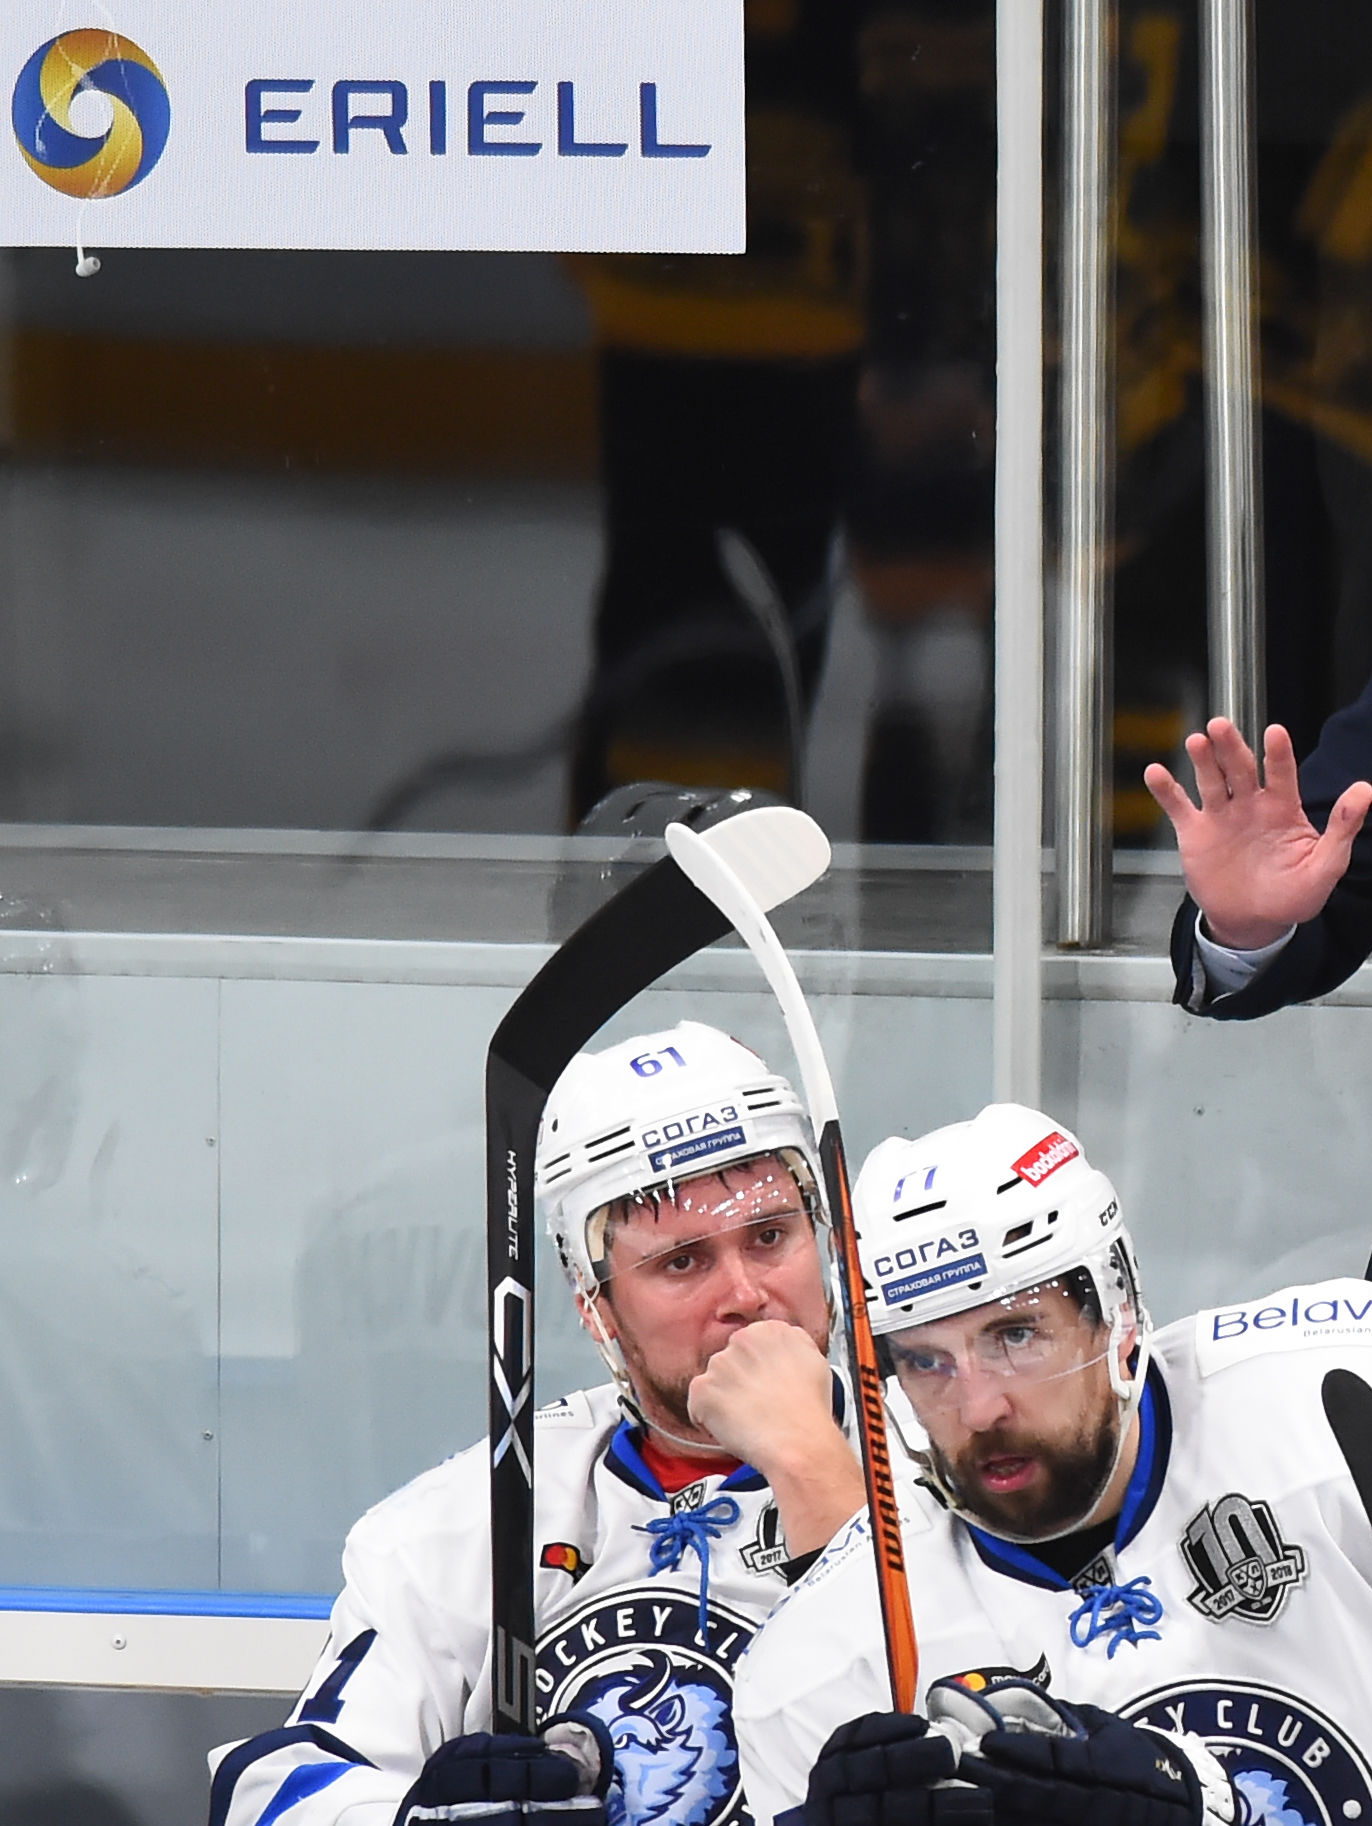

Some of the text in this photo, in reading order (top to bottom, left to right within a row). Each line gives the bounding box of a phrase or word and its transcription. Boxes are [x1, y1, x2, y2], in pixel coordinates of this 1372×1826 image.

[245, 79, 712, 157] ERIELL
[630, 1047, 687, 1078] 61
[642, 1106, 739, 1149] СОГАЗ
[507, 1149, 519, 1261] HYPERLITE
[874, 1228, 980, 1278] СОГАЗ
[887, 1260, 983, 1298] СТРАХОВАЯ ГРУППА
[1303, 1327, 1371, 1338] Belarusian
[860, 1364, 906, 1577] WARRIOR
[760, 1549, 782, 1566] 2017
[1213, 1588, 1236, 1611] 2017
[534, 1604, 672, 1724] OCKEY
[1216, 1700, 1331, 1768] CLUB
